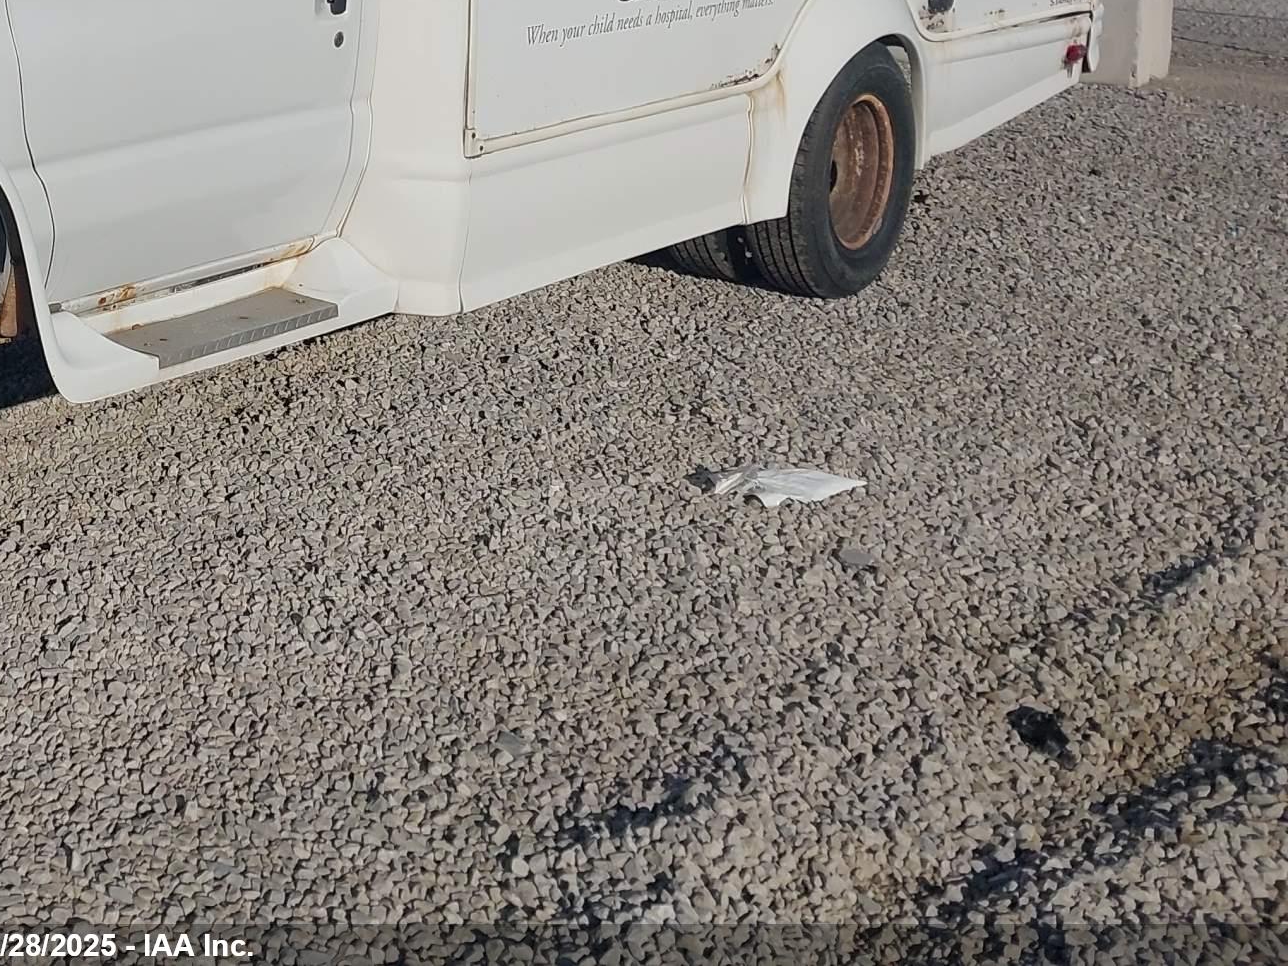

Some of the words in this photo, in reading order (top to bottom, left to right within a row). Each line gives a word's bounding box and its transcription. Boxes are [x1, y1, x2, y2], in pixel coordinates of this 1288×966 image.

[527, 23, 558, 45] When
[559, 24, 585, 47] your
[588, 12, 615, 36] child
[616, 8, 643, 31] needs
[645, 14, 652, 26] a
[655, 0, 692, 28] hospital,
